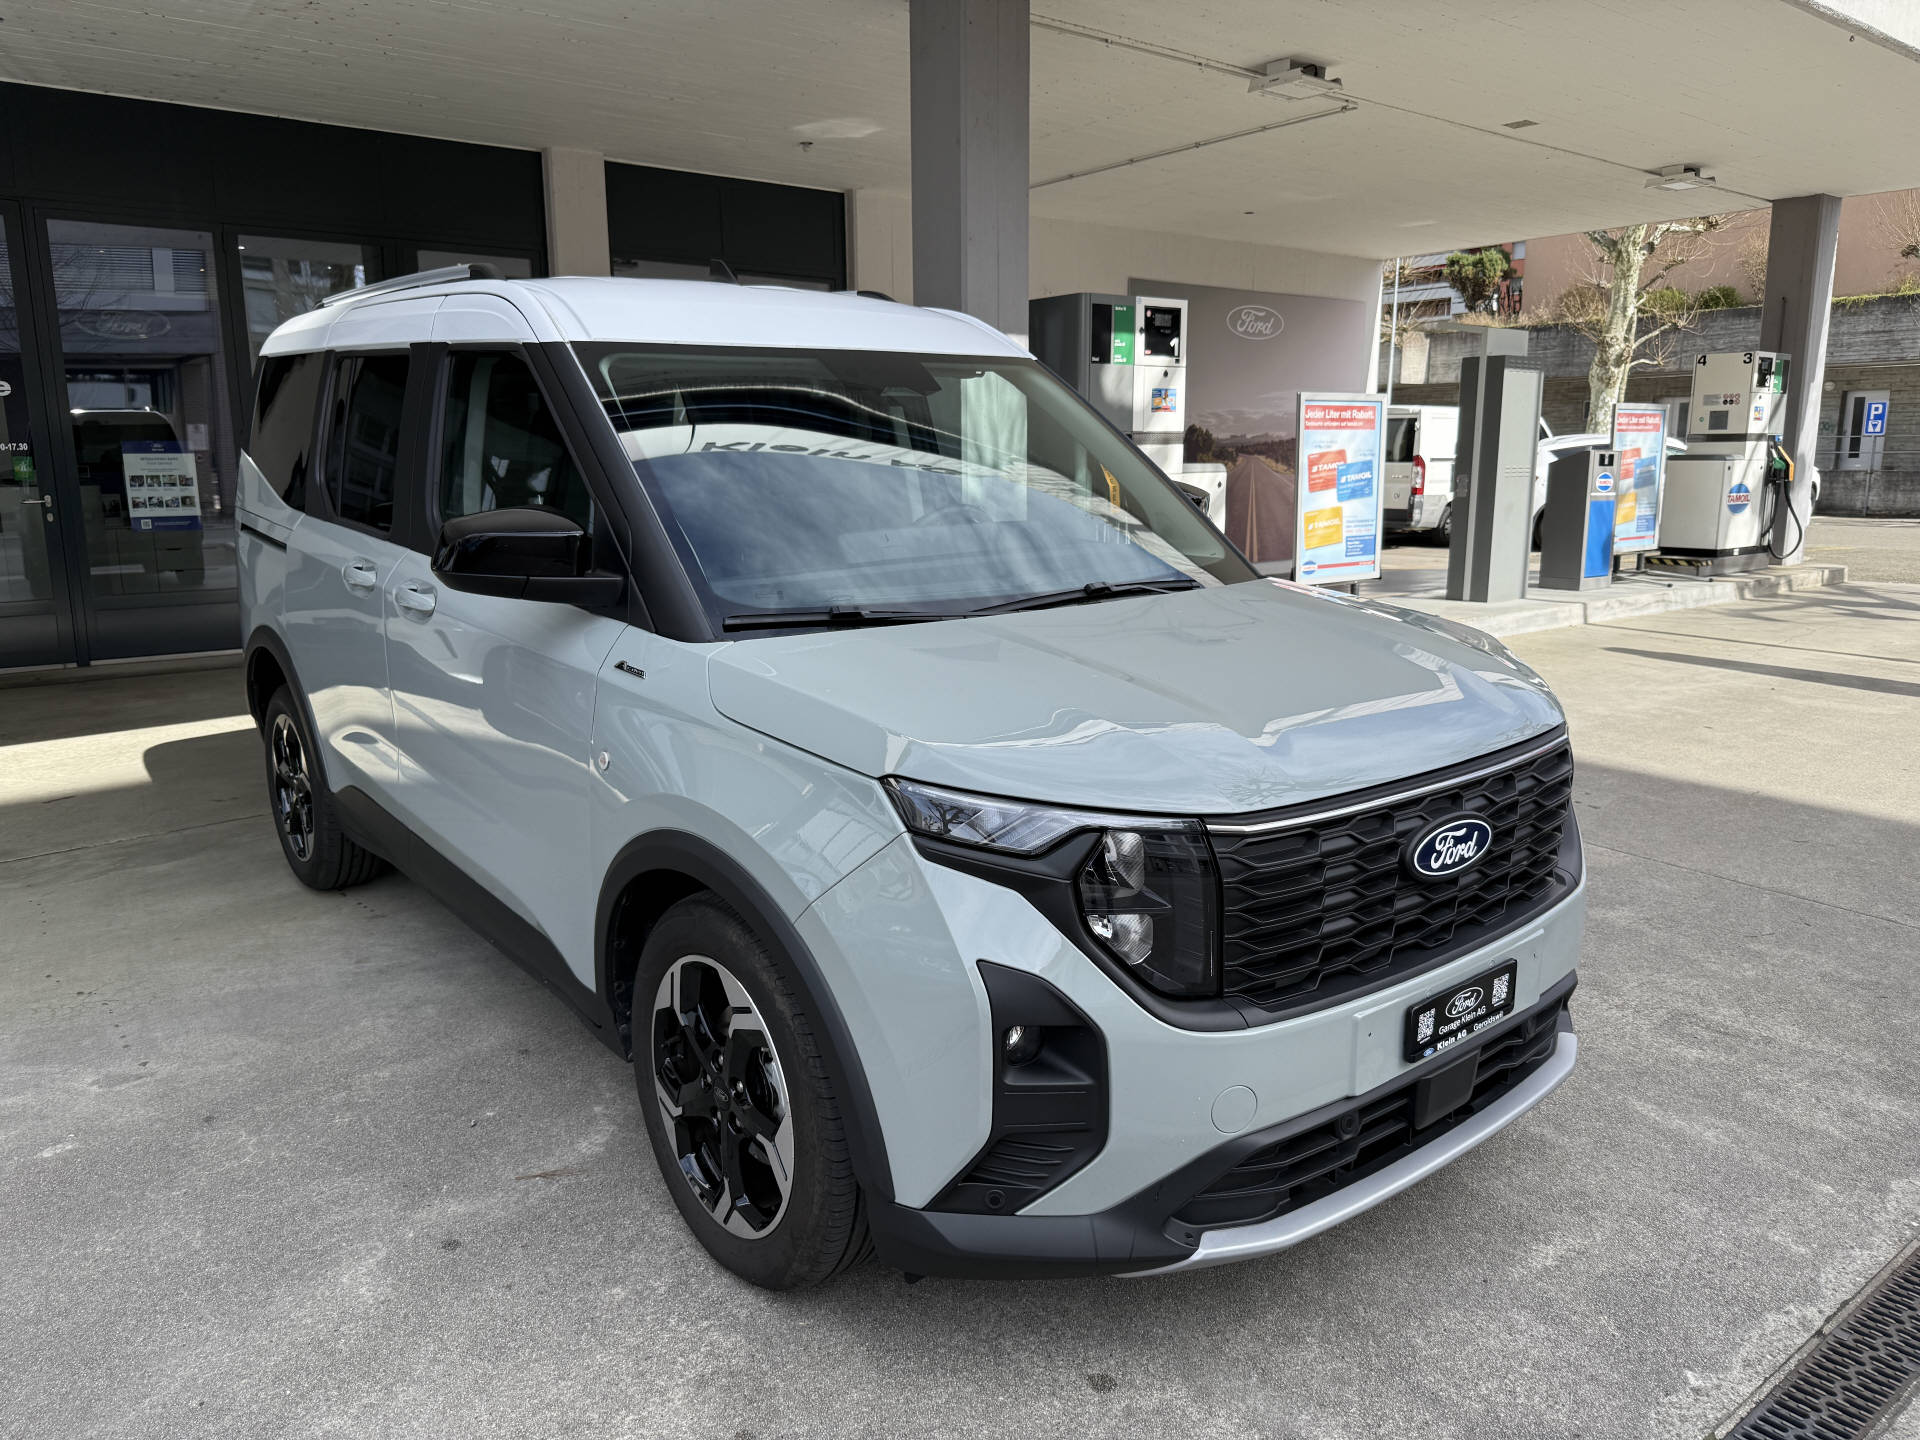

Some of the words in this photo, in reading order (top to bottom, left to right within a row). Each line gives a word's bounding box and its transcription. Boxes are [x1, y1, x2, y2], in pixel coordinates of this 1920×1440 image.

[1237, 308, 1275, 335] Ford
[1169, 336, 1180, 357] 1
[1697, 354, 1707, 366] 4
[1743, 352, 1753, 365] 3
[1305, 407, 1325, 419] Jeder
[1325, 407, 1340, 419] Liter
[1341, 408, 1352, 419] mit
[1870, 403, 1883, 420] P
[1727, 493, 1752, 504] TAMOIL
[1430, 827, 1479, 870] Ford
[1451, 991, 1477, 1015] Ford
[1438, 1017, 1461, 1035] Garage
[1461, 1010, 1477, 1024] Klein
[1476, 1005, 1487, 1016] AG
[1473, 1010, 1504, 1032] Geroldswil
[1436, 1037, 1456, 1051] Klein
[1456, 1028, 1468, 1041] AG
